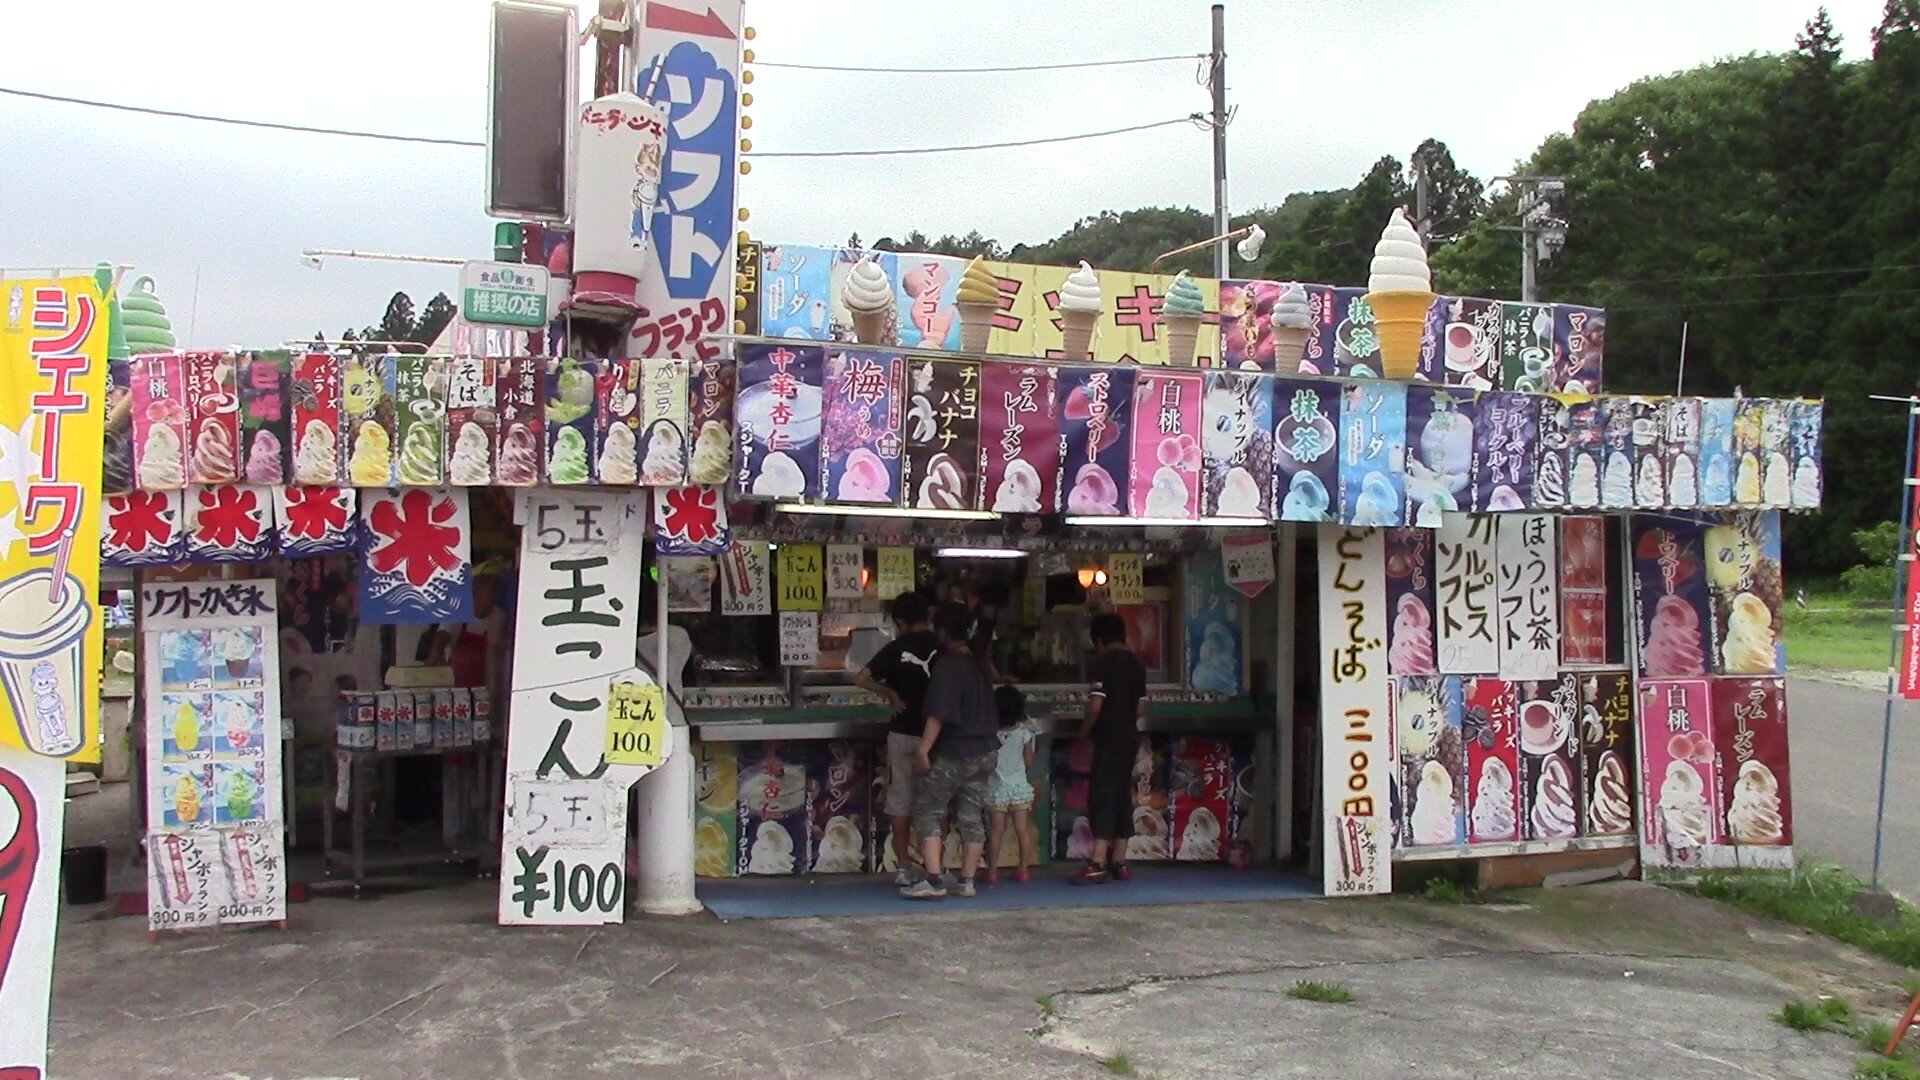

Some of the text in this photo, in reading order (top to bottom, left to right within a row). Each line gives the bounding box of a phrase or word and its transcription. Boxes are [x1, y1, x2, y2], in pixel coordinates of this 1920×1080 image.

[664, 73, 725, 280] ソフト
[473, 290, 540, 316] 推奨の店
[786, 254, 808, 317] ソーダ
[923, 262, 941, 334] マンゴー
[632, 297, 725, 359] フランク
[1347, 297, 1374, 358] 抹茶
[1566, 312, 1588, 377] マロン
[148, 357, 169, 400] 白桃
[314, 365, 325, 393] バニラ
[460, 363, 478, 402] そば
[504, 387, 519, 420] 小倉
[520, 360, 535, 406] 北海道
[655, 363, 673, 416] バニラ
[703, 362, 720, 416] マロン
[768, 347, 795, 451] 中華杏仁
[841, 359, 888, 405] 梅
[960, 366, 977, 420] チョコ
[1019, 377, 1038, 413] ラム
[25, 287, 96, 552] シェーク
[856, 406, 871, 439] うめ
[939, 390, 960, 451] バナナ
[1000, 392, 1025, 461] レーズン
[1086, 372, 1111, 463] ストロベリー
[1158, 379, 1182, 435] 白桃
[1290, 389, 1321, 464] 抹茶
[1365, 394, 1386, 461] ソーダ
[1676, 406, 1690, 437] そば
[109, 489, 172, 552] 氷
[195, 488, 261, 550] 氷
[286, 487, 348, 540] 氷
[367, 489, 461, 587] 氷
[538, 504, 608, 549] 5玉
[666, 486, 717, 543] 氷
[784, 555, 817, 573] 玉こん
[1466, 513, 1494, 643] カルピス
[1523, 517, 1553, 650] ほうじ茶
[1657, 527, 1680, 595] トロベリー
[1438, 542, 1462, 639] ソフト
[1501, 564, 1522, 650] ソフト
[614, 697, 657, 722] 玉こん
[1491, 695, 1503, 735] バニラ
[1551, 686, 1565, 739] プリン
[1604, 697, 1619, 748] バナナ
[1615, 676, 1630, 722] チョコ
[1667, 684, 1691, 732] 白桃
[1747, 688, 1768, 720] ラム
[1732, 702, 1755, 763] レーズン
[526, 792, 593, 835] 5玉
[512, 846, 622, 918] ¥100
